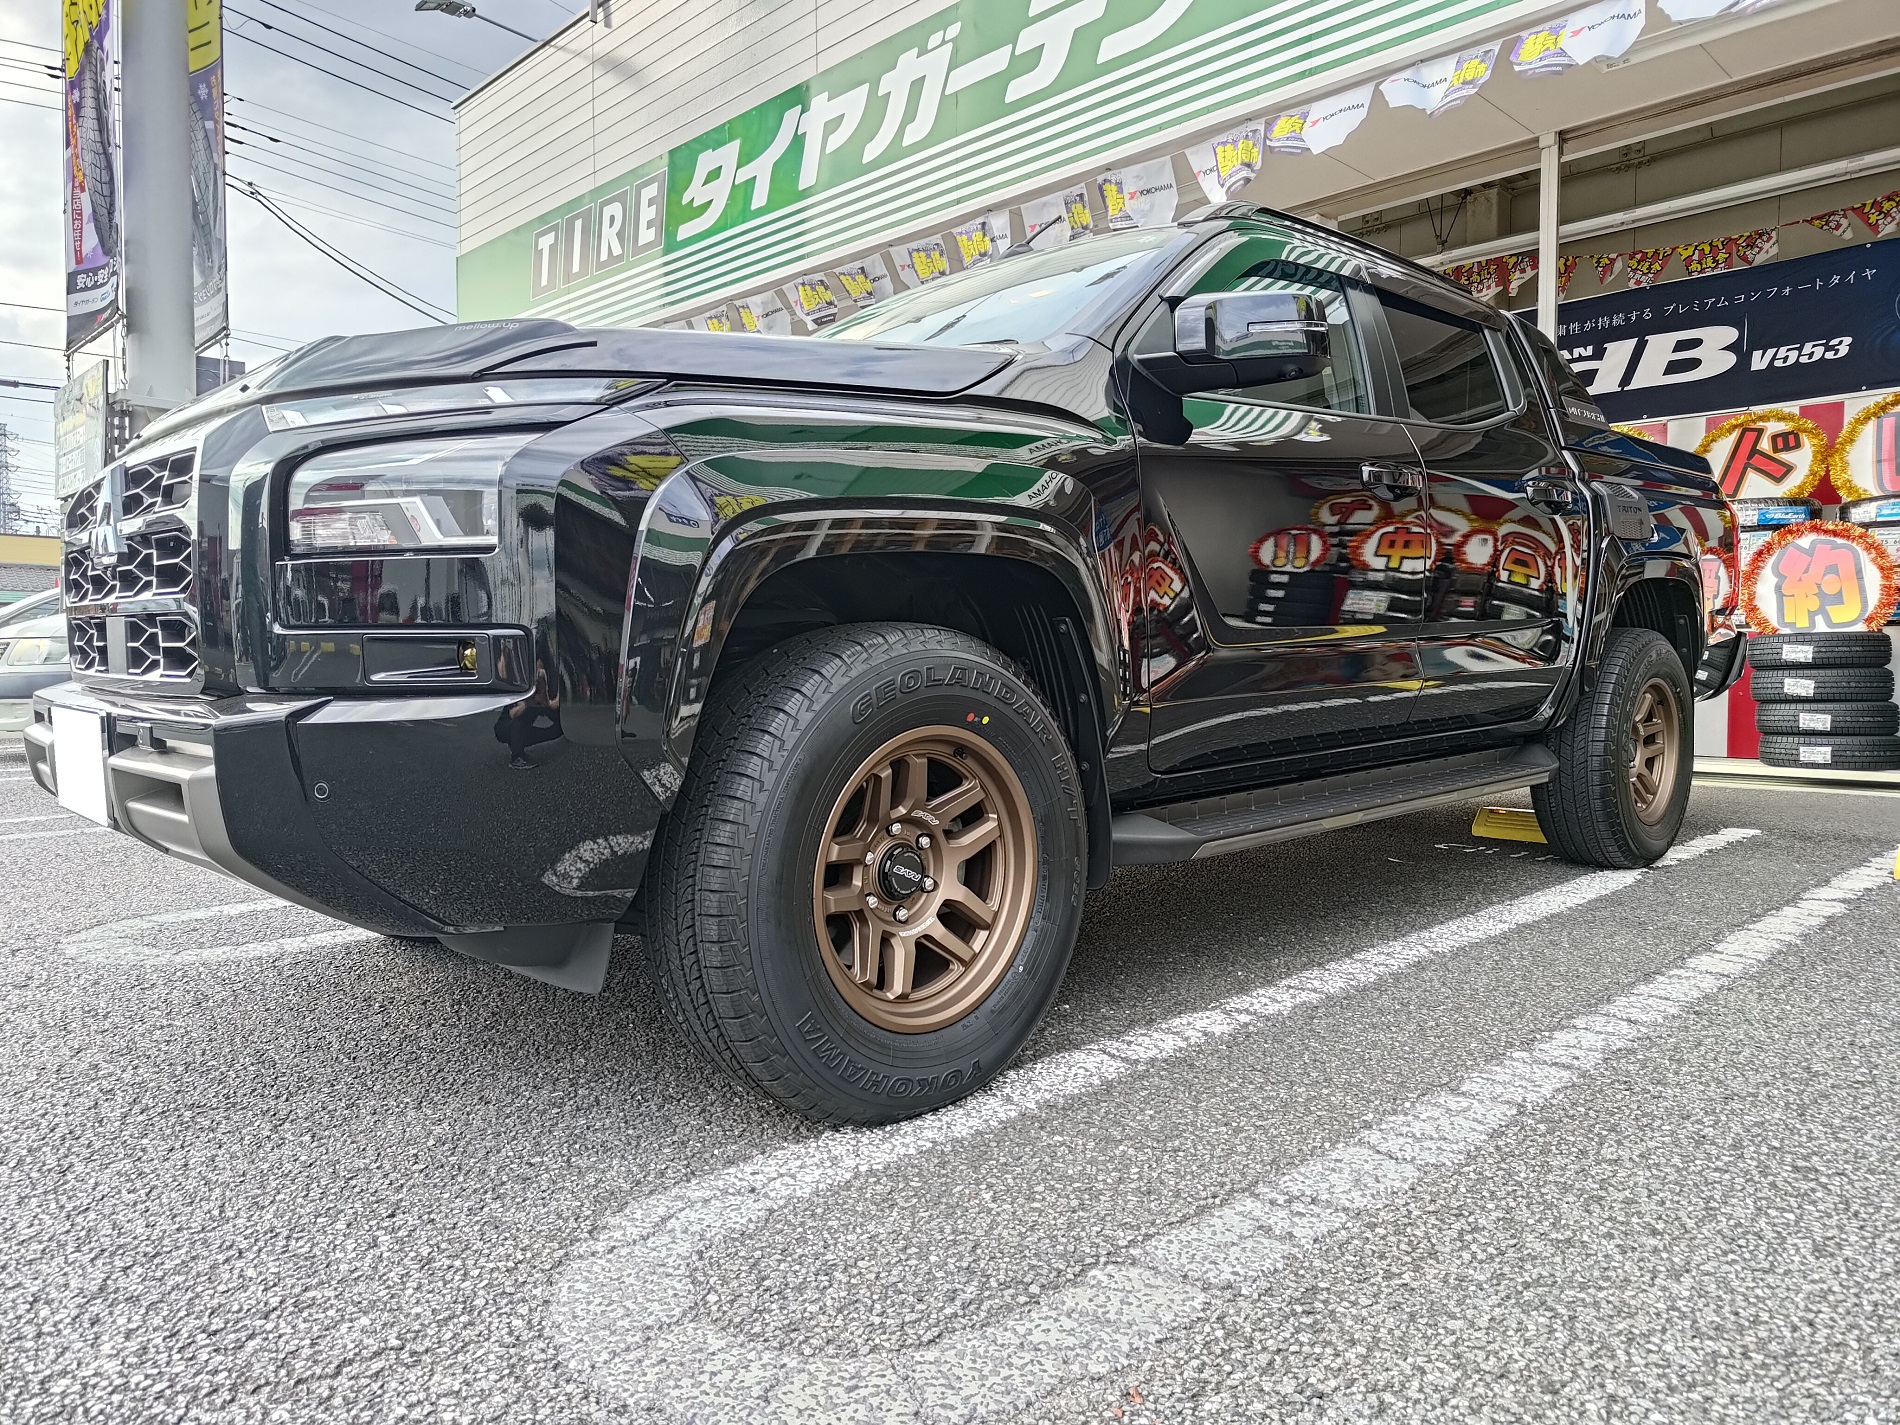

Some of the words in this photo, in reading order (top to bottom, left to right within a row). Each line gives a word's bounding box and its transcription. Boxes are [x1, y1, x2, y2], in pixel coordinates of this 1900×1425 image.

[1587, 8, 1642, 31] YOKOHAMA
[1322, 103, 1365, 122] YOKOHAMA
[1139, 183, 1174, 196] YOKOHAMA
[537, 183, 660, 287] TIRE
[1663, 268, 1878, 317] プレミアムコンフォートタイヤ
[454, 320, 520, 332] mellow.up
[1750, 336, 1854, 372] V553
[1719, 427, 1803, 500] ド
[1618, 505, 1642, 514] TRITON
[1773, 511, 1806, 520] BluEarth
[1777, 540, 1867, 632] 約
[850, 665, 1053, 747] GEOLANDAR
[893, 865, 922, 882] RAYS
[796, 1011, 984, 1099] YOKOHAMA
